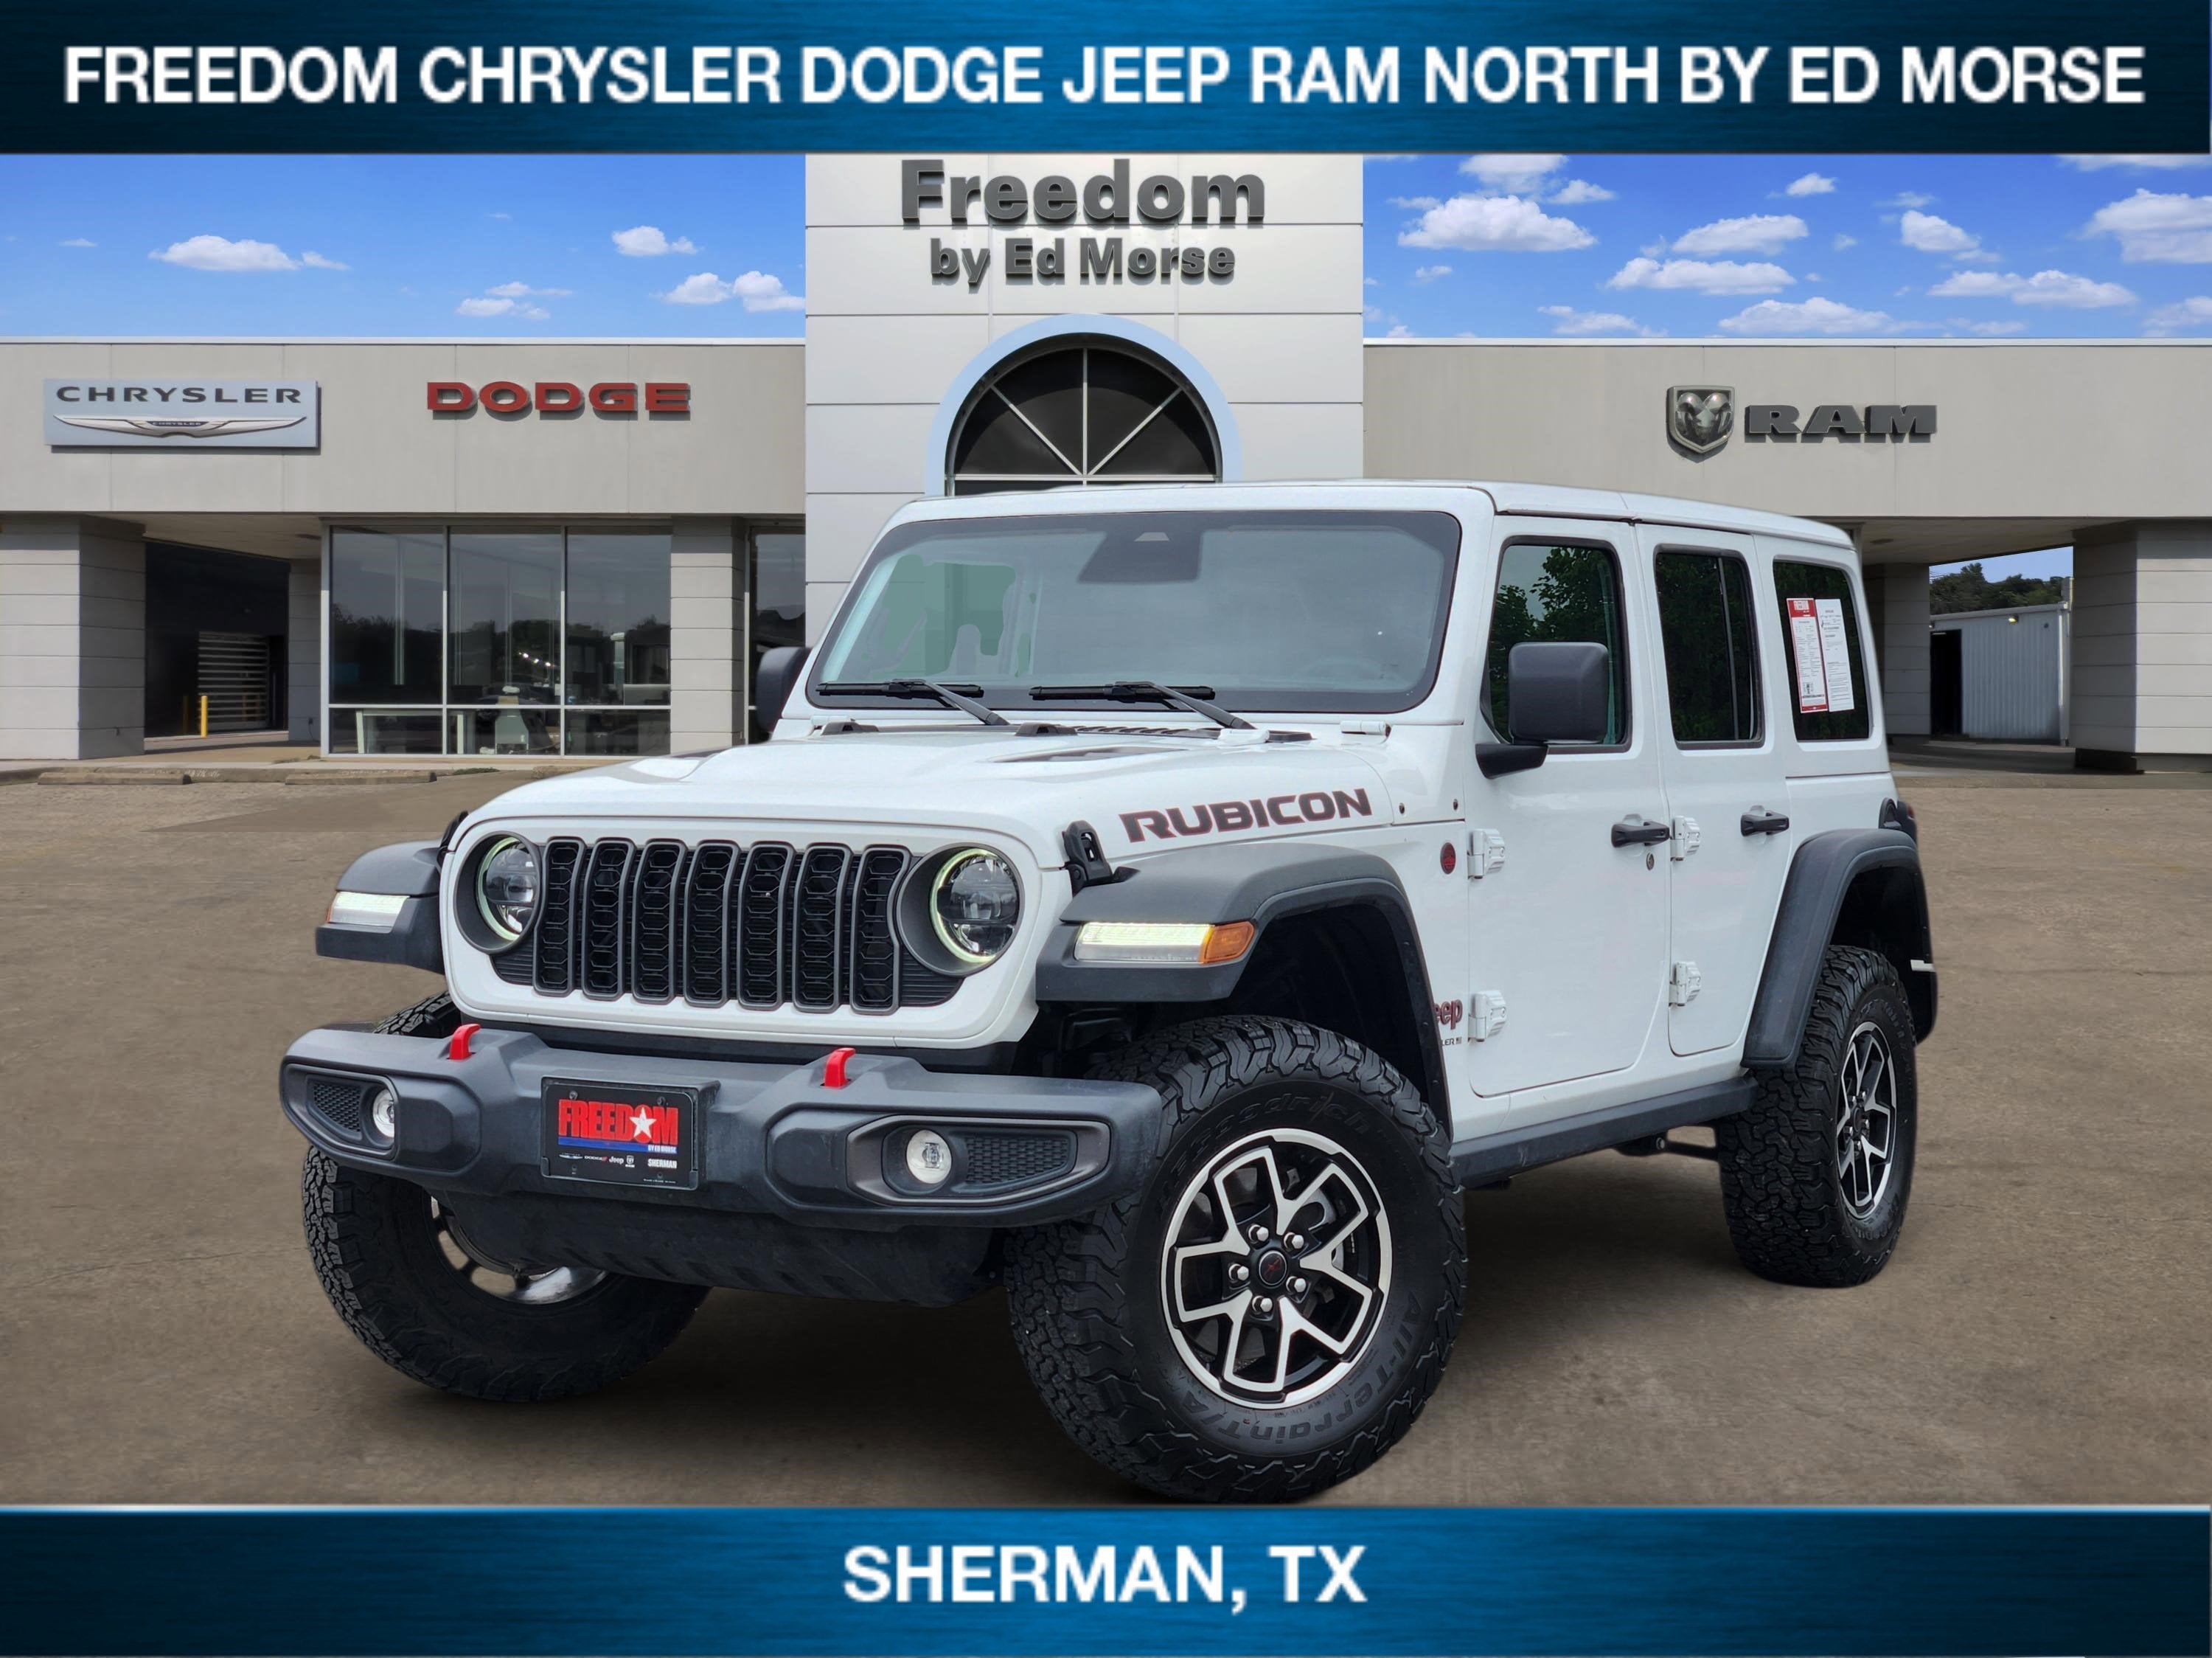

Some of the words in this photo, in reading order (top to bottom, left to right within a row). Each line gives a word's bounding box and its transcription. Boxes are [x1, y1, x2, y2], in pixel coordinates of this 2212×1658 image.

[901, 158, 1265, 221] Freedom
[931, 237, 990, 286] by
[1005, 237, 1065, 277] Ed
[1080, 237, 1236, 279] Morse
[56, 386, 302, 403] CHRYSLER
[427, 381, 690, 412] DODGE
[1745, 404, 1938, 435] RAM
[1118, 787, 1374, 844] RUBICON
[1434, 999, 1464, 1030] eep
[558, 1098, 679, 1145] FREEDOM
[609, 1156, 625, 1165] Jeep
[647, 1158, 678, 1169] SHERMAN
